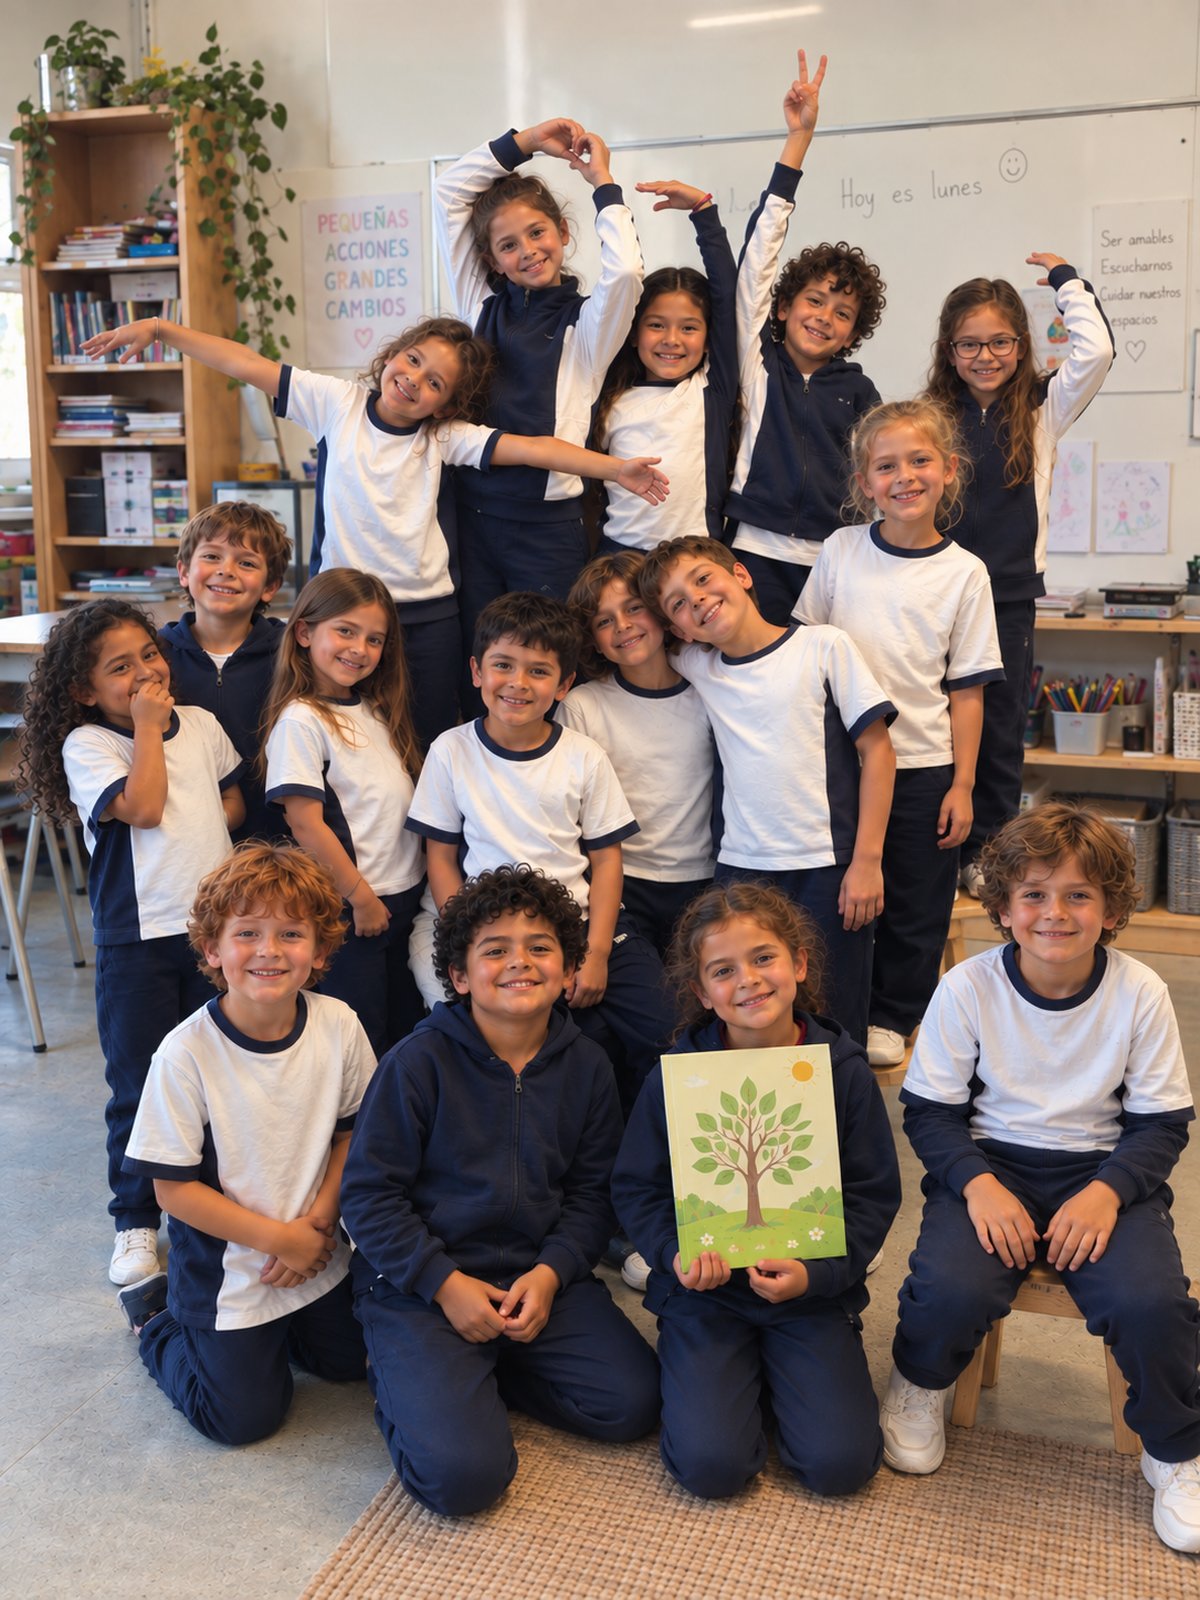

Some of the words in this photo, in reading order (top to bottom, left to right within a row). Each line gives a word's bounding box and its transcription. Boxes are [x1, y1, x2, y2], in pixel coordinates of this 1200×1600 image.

[841, 177, 875, 219] Hoy
[892, 188, 914, 203] es
[931, 169, 983, 200] lunes
[317, 205, 409, 234] PEQUEÑAS
[1100, 229, 1122, 248] Ser
[1128, 228, 1174, 246] amables
[325, 238, 410, 262] ACCIONES
[1100, 257, 1173, 275] Escucharnos
[324, 267, 408, 291] GRANDES
[1099, 286, 1135, 302] Cuidar
[1139, 285, 1181, 300] nuestros
[325, 297, 406, 320] CAMBIOS
[1111, 314, 1158, 331] espacios
